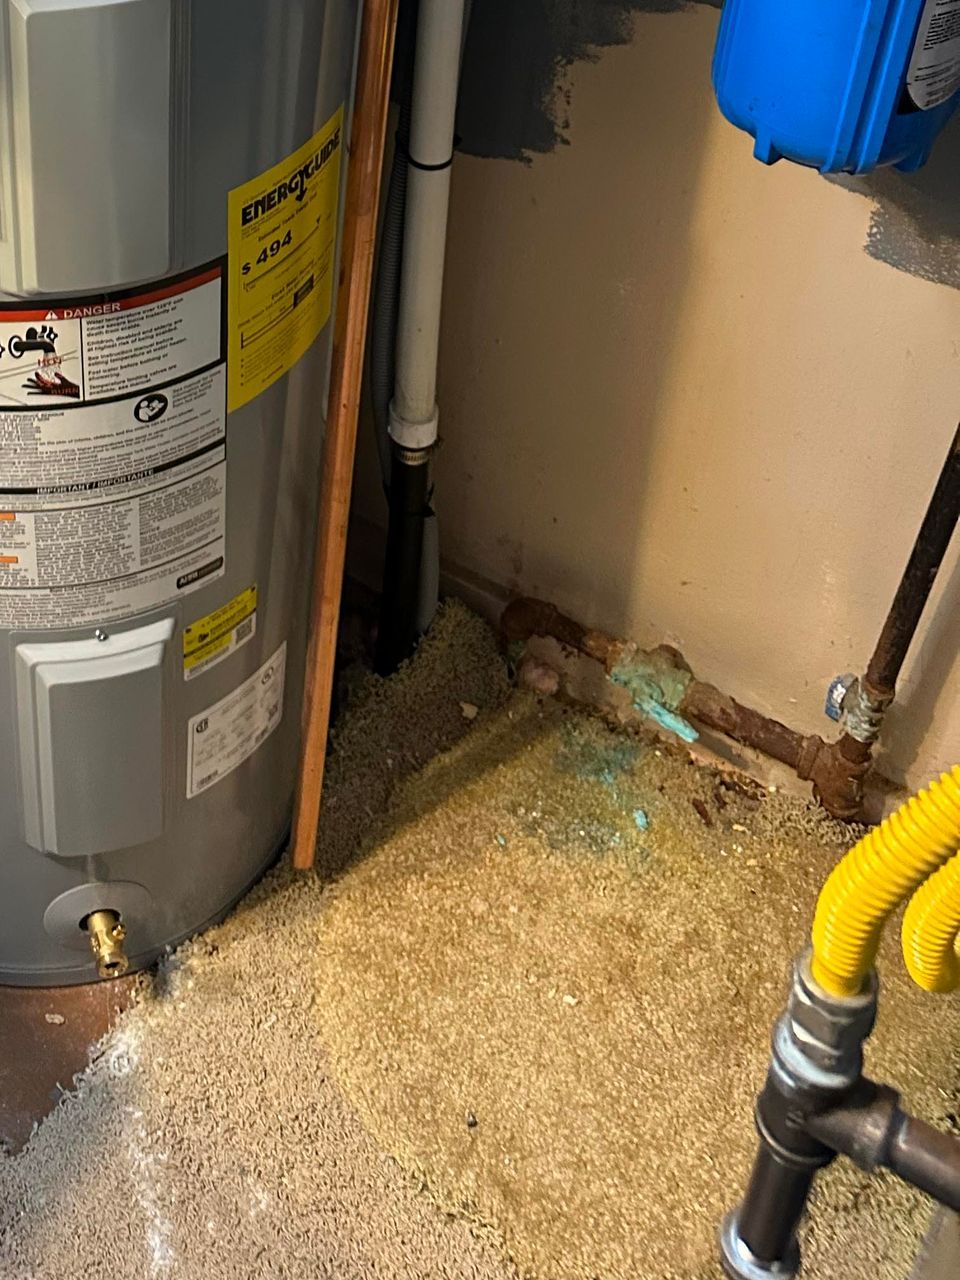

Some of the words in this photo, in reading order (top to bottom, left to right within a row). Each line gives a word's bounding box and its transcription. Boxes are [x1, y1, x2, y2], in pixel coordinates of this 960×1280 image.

[242, 128, 340, 226] ENERGYGUIDE
[256, 230, 292, 265] 494
[63, 302, 121, 319] DANGER
[38, 484, 90, 494] IMPORTANT
